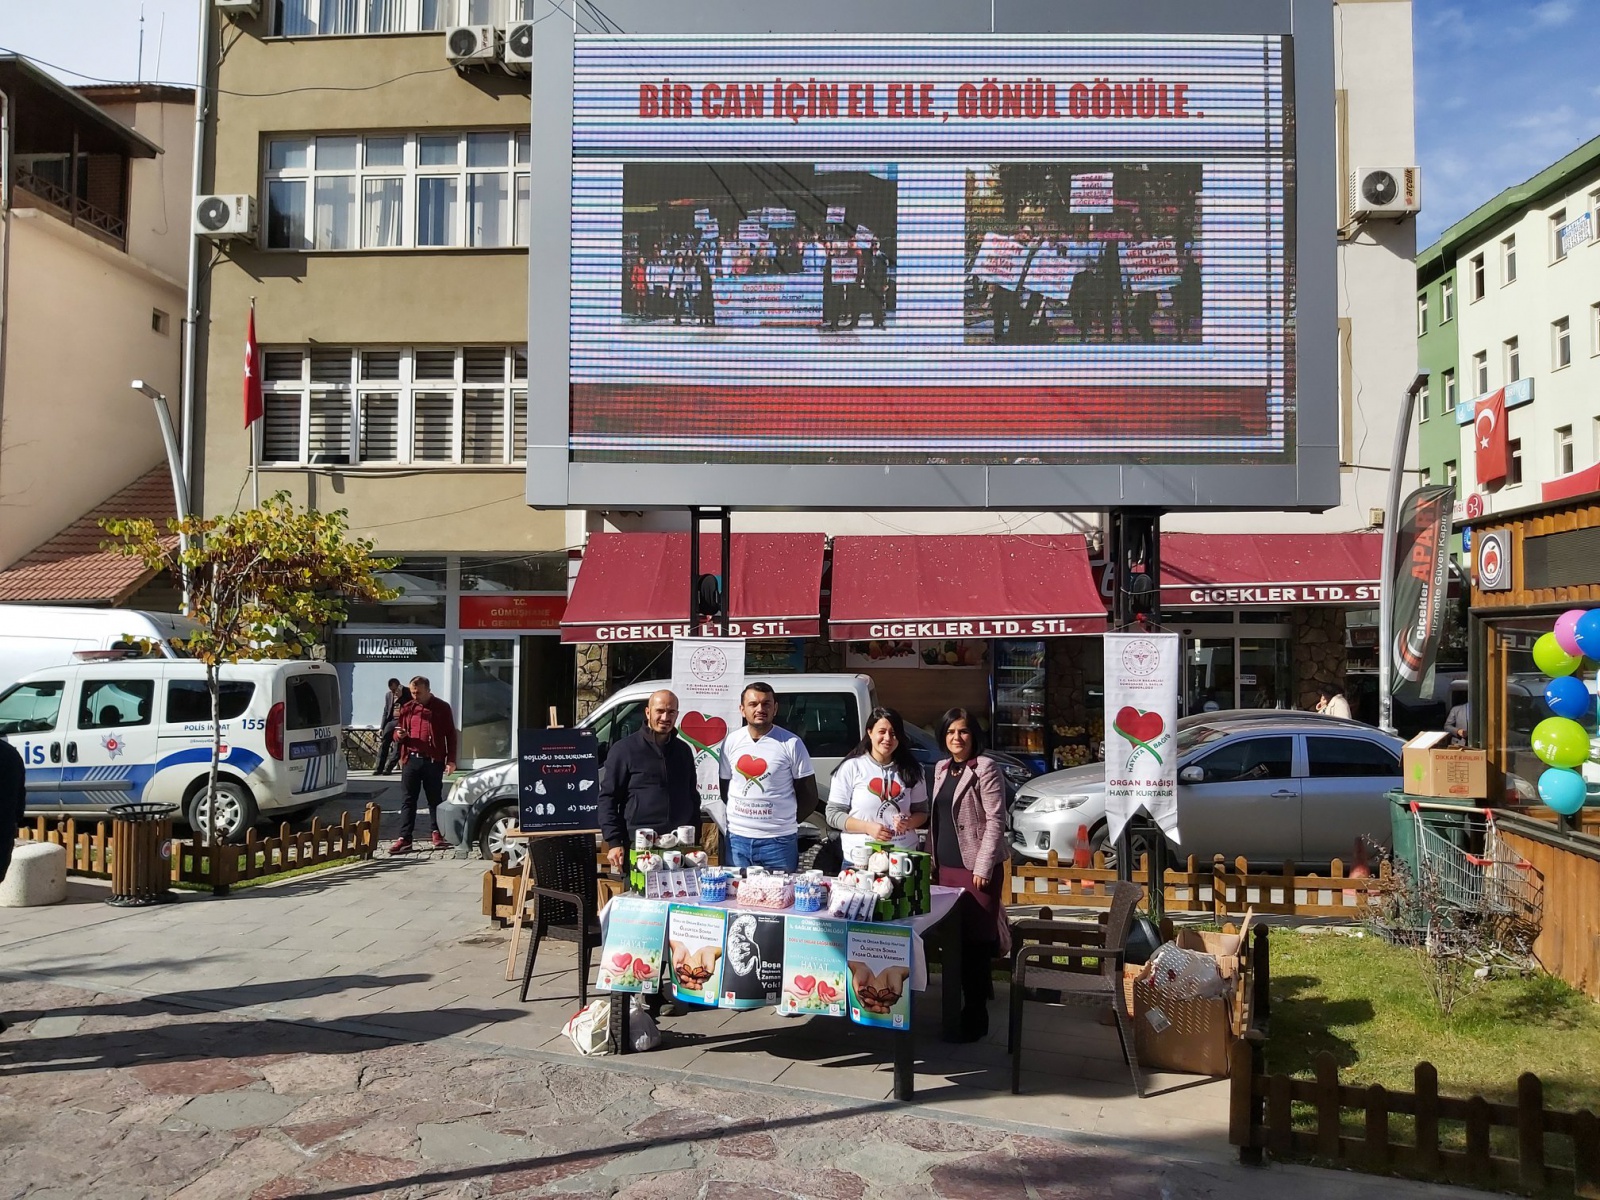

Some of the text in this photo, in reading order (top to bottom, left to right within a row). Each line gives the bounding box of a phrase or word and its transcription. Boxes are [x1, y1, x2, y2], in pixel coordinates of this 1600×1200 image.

[639, 77, 692, 118] BİR
[701, 83, 764, 119] CAN
[773, 77, 839, 125] İÇİN
[847, 84, 879, 118] EL
[957, 77, 1061, 119] GÖNÜL
[1435, 550, 1445, 586] Güven
[1303, 587, 1350, 600] LTD.
[979, 620, 1026, 635] LTD.
[242, 719, 265, 730] 155
[524, 754, 552, 762] BOŞLUĞU
[1146, 778, 1174, 788] BAĞIŞI
[1109, 789, 1173, 797] HAYAT KURTARIR
[762, 960, 781, 970] Boşa
[801, 960, 829, 972] HAYAT
[762, 981, 781, 989] Yok!
